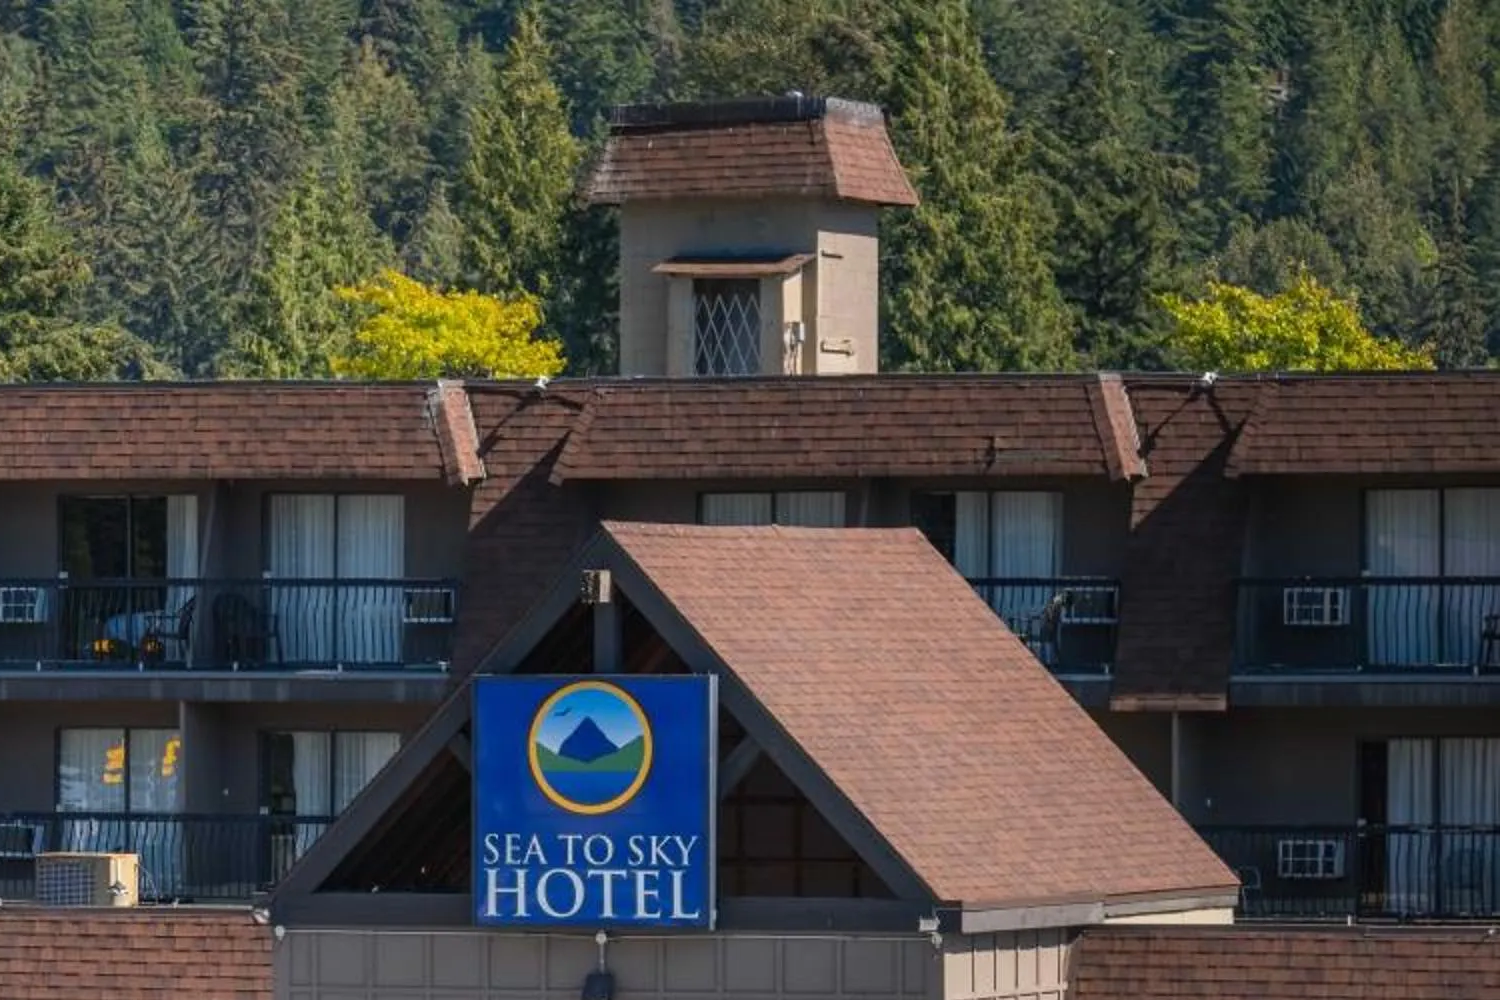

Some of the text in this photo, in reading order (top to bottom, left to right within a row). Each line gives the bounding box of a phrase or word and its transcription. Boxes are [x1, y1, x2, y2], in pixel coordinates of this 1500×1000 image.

[483, 833, 699, 866] SEA TO SKY
[483, 867, 700, 919] HOTEL
